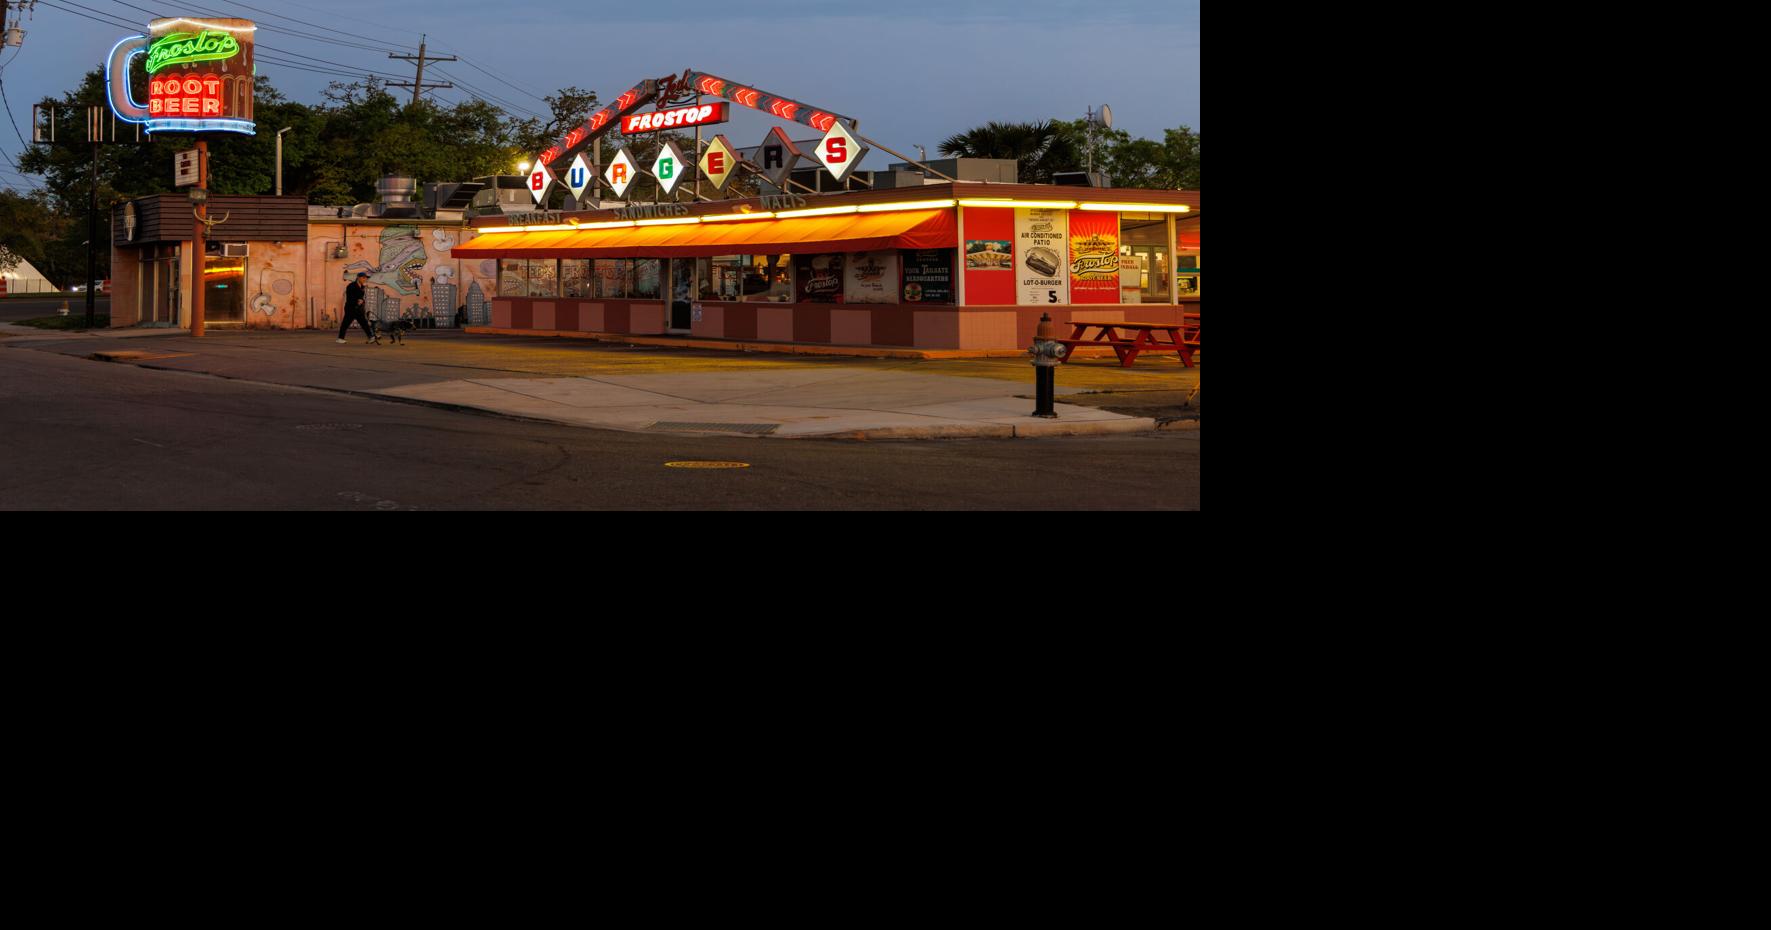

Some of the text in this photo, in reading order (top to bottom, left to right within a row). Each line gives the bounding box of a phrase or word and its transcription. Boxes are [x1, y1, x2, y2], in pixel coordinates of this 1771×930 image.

[146, 30, 239, 73] Frostop
[151, 80, 219, 95] ROOT
[150, 98, 219, 113] BEER
[628, 105, 712, 131] FROSTOP
[531, 137, 847, 191] BURGERS
[760, 193, 806, 210] MALTS
[508, 211, 561, 225] BREAKFAST
[614, 204, 688, 220] SANDWICHES
[1048, 291, 1057, 303] 5
